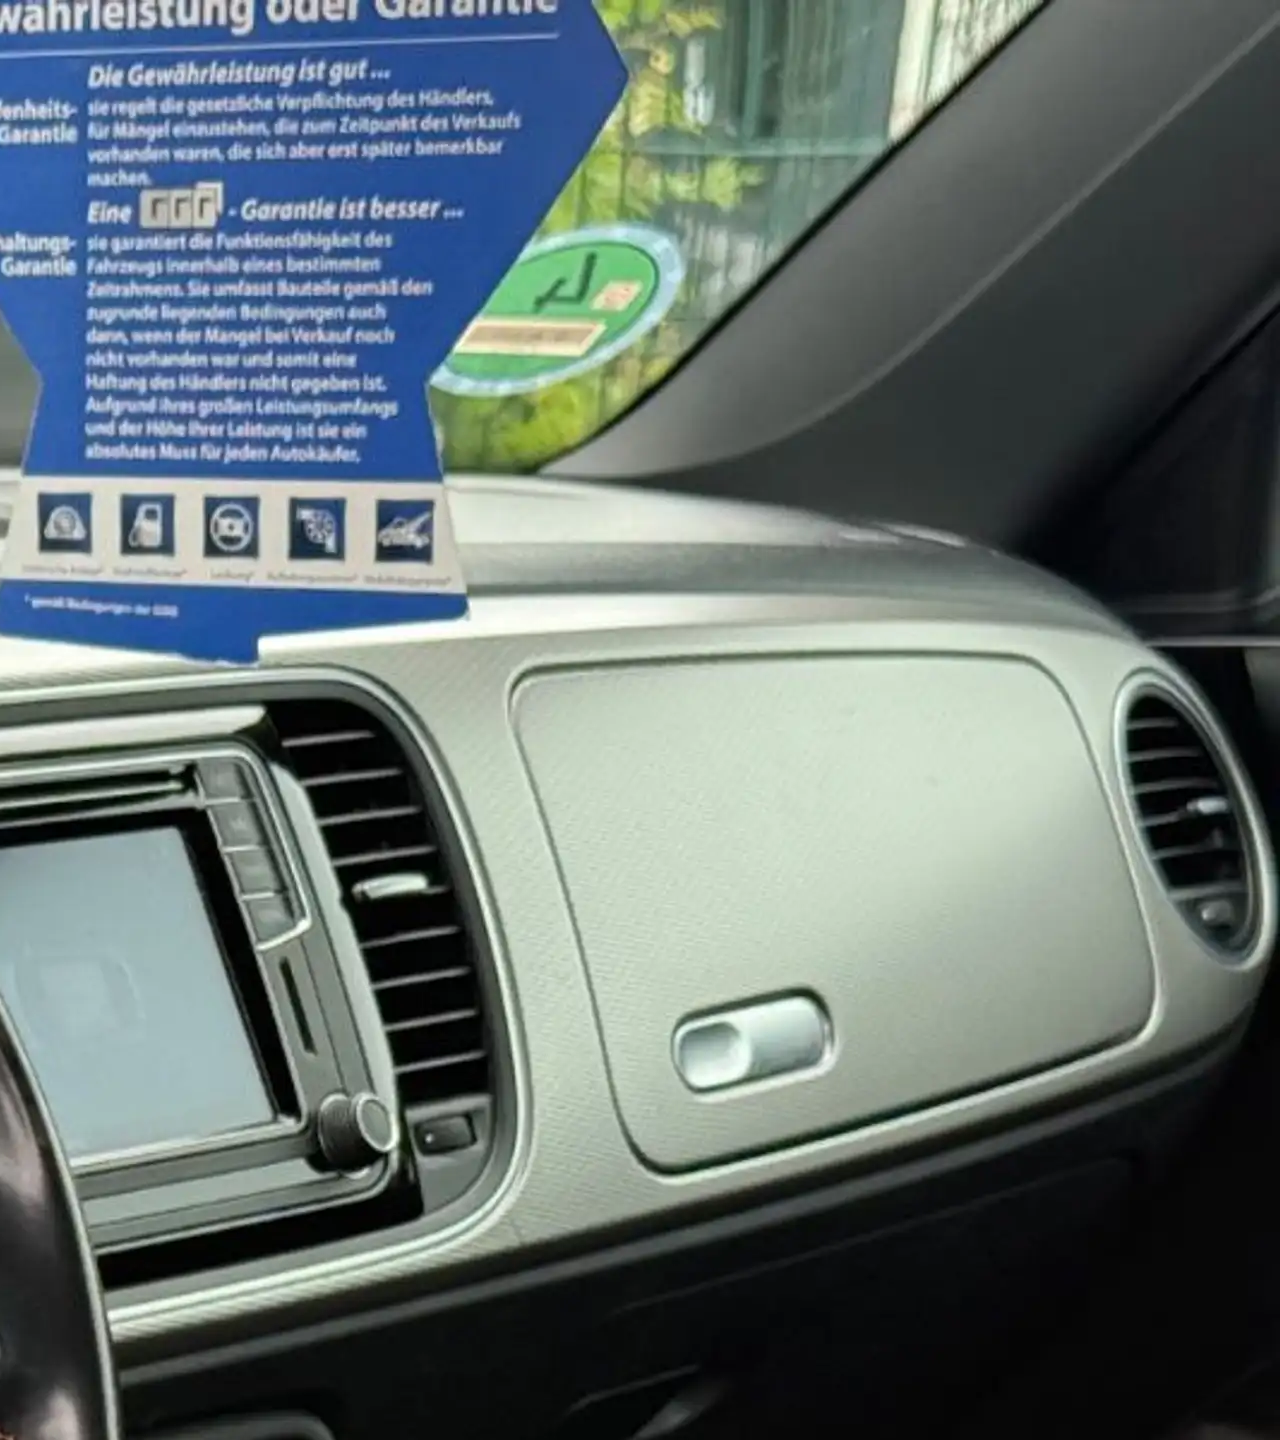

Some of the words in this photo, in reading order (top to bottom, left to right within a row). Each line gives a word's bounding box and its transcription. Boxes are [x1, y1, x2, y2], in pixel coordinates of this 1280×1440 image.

[266, 0, 357, 23] oder
[88, 64, 123, 88] Die
[127, 61, 294, 87] Gewährleistung
[299, 58, 326, 82] ist
[329, 57, 367, 86] gut
[88, 201, 132, 224] Eine
[241, 197, 336, 220] Garantie
[340, 196, 366, 219] ist
[370, 195, 441, 219] besser
[0, 256, 78, 277] Garantie
